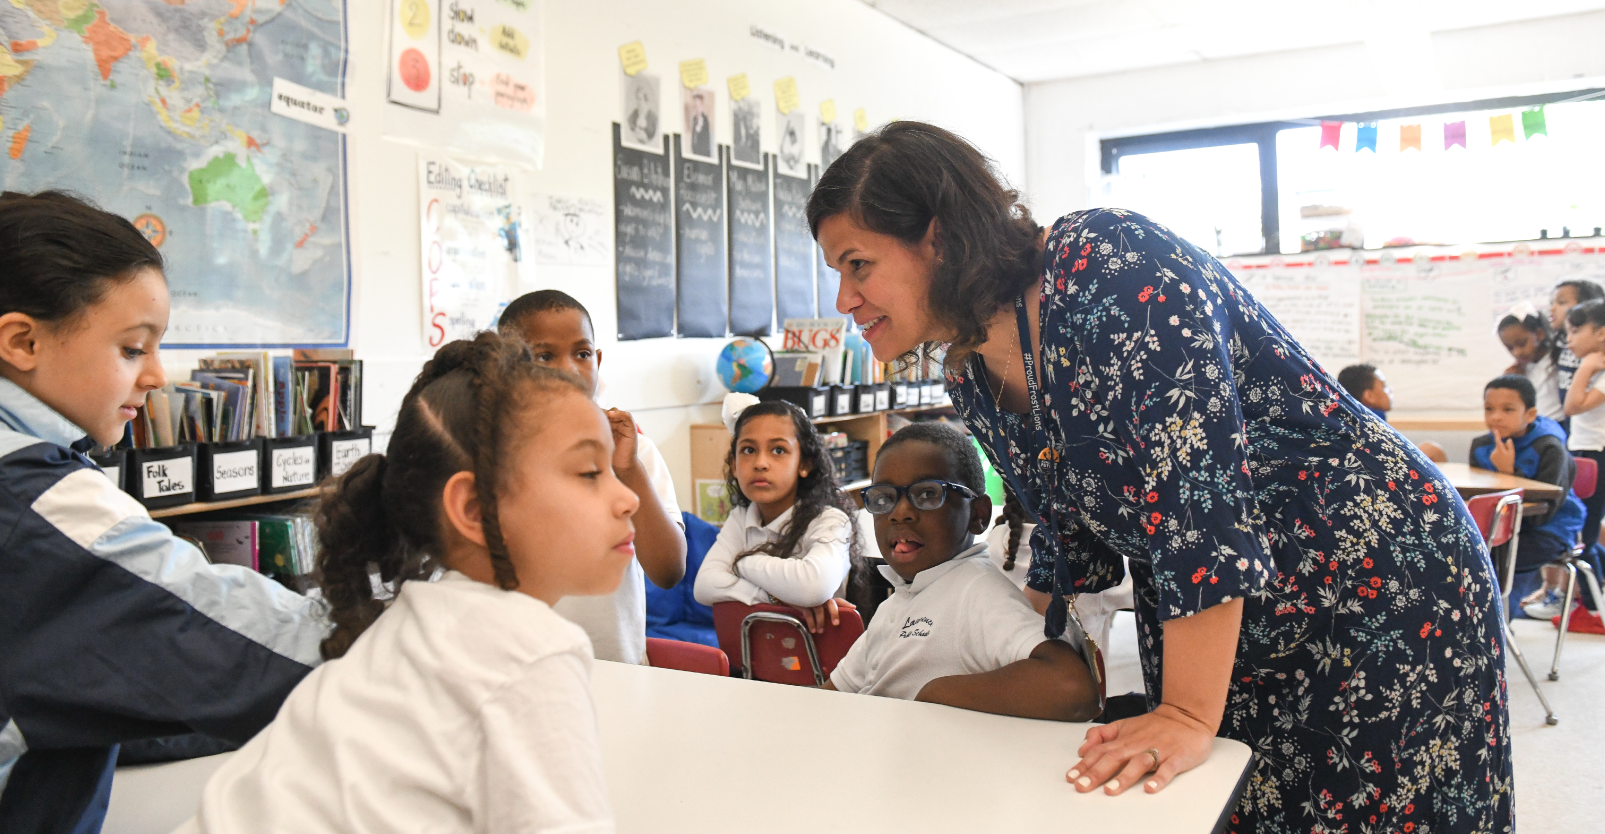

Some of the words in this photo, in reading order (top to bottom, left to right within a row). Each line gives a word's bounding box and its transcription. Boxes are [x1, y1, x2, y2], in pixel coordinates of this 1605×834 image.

[407, 2, 423, 28] 2
[447, 24, 478, 52] down
[278, 92, 324, 115] equator
[119, 162, 147, 171] OCEAN
[427, 161, 462, 199] Editing
[467, 167, 509, 198] Checklist
[170, 289, 198, 297] OCEAN
[429, 312, 447, 347] S
[782, 328, 839, 350] BUGS
[1023, 353, 1042, 431] #ProudFrostLions
[276, 451, 303, 472] Cycles
[335, 443, 360, 460] Earth
[146, 464, 168, 479] Folk
[215, 464, 254, 480] Seasons
[282, 471, 310, 484] Nature
[157, 478, 185, 493] Tales
